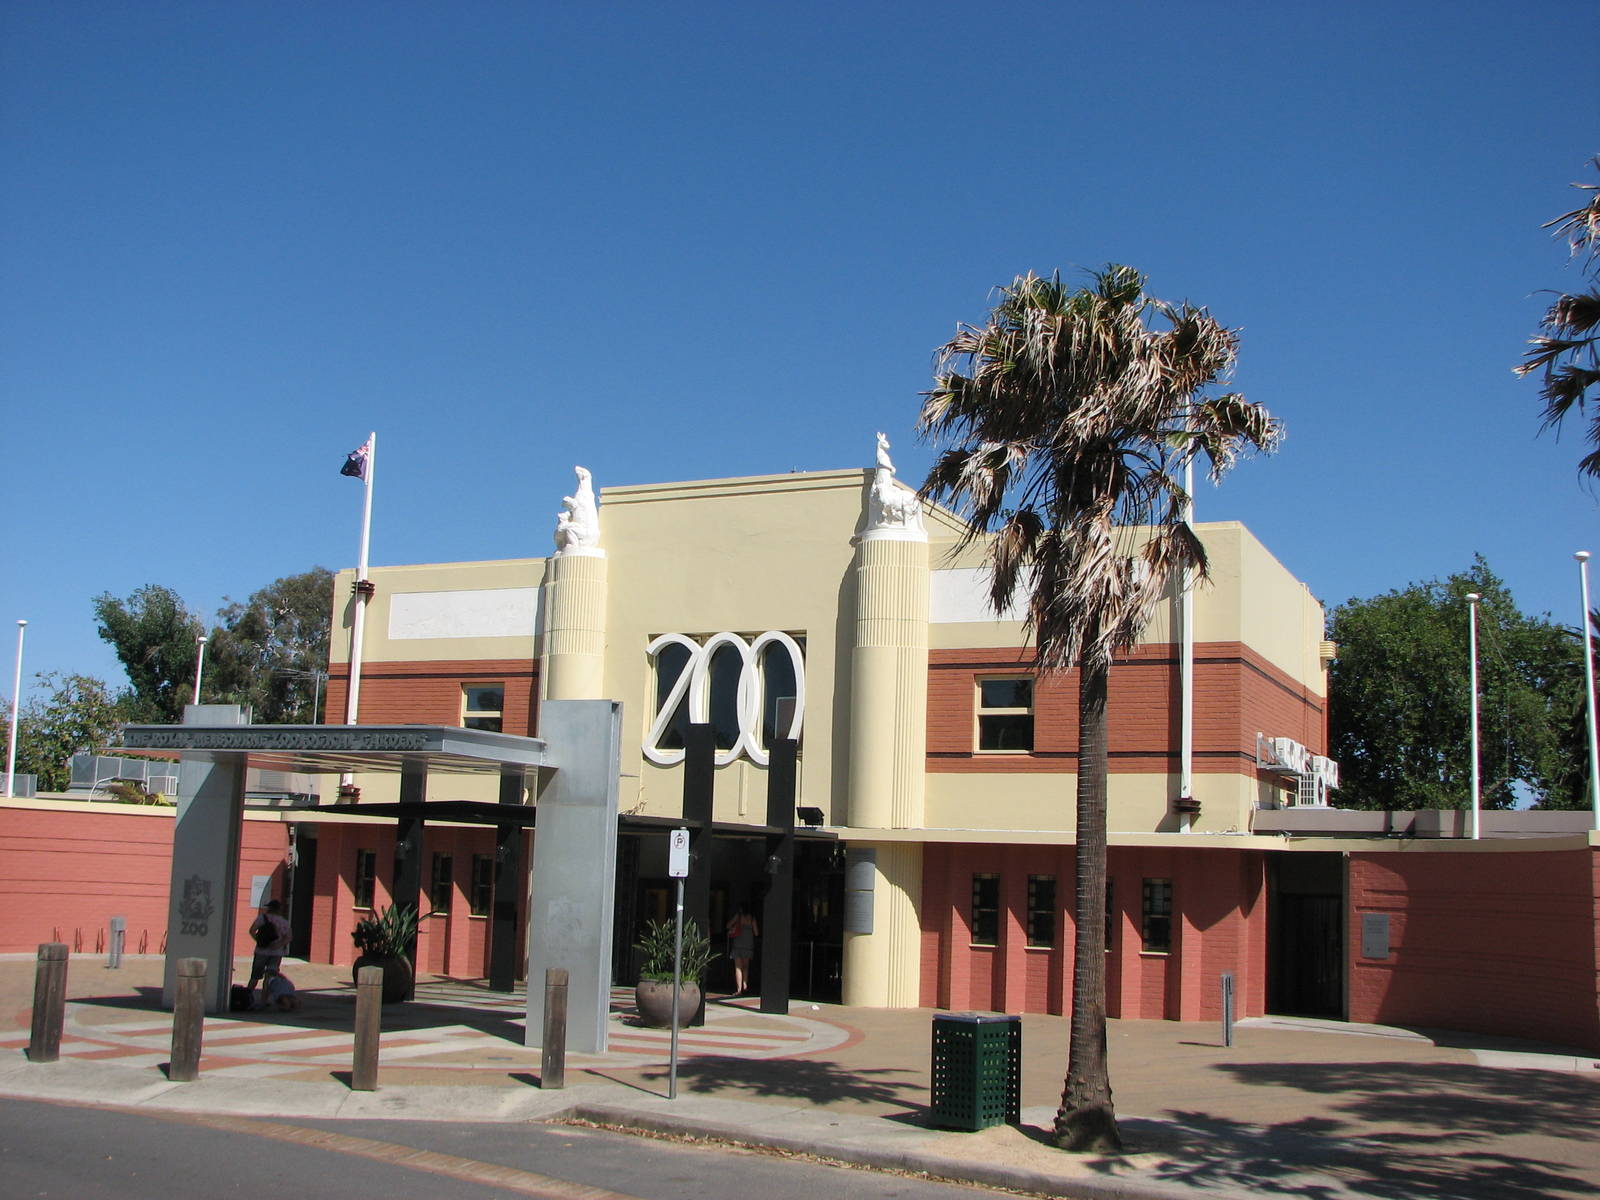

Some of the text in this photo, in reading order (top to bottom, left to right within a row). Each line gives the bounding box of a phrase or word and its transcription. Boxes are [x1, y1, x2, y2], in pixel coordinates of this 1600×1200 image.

[642, 631, 805, 765] ZOO
[194, 733, 268, 747] MELBOURNE
[362, 734, 426, 748] GARDENS
[180, 921, 208, 936] ZOO
